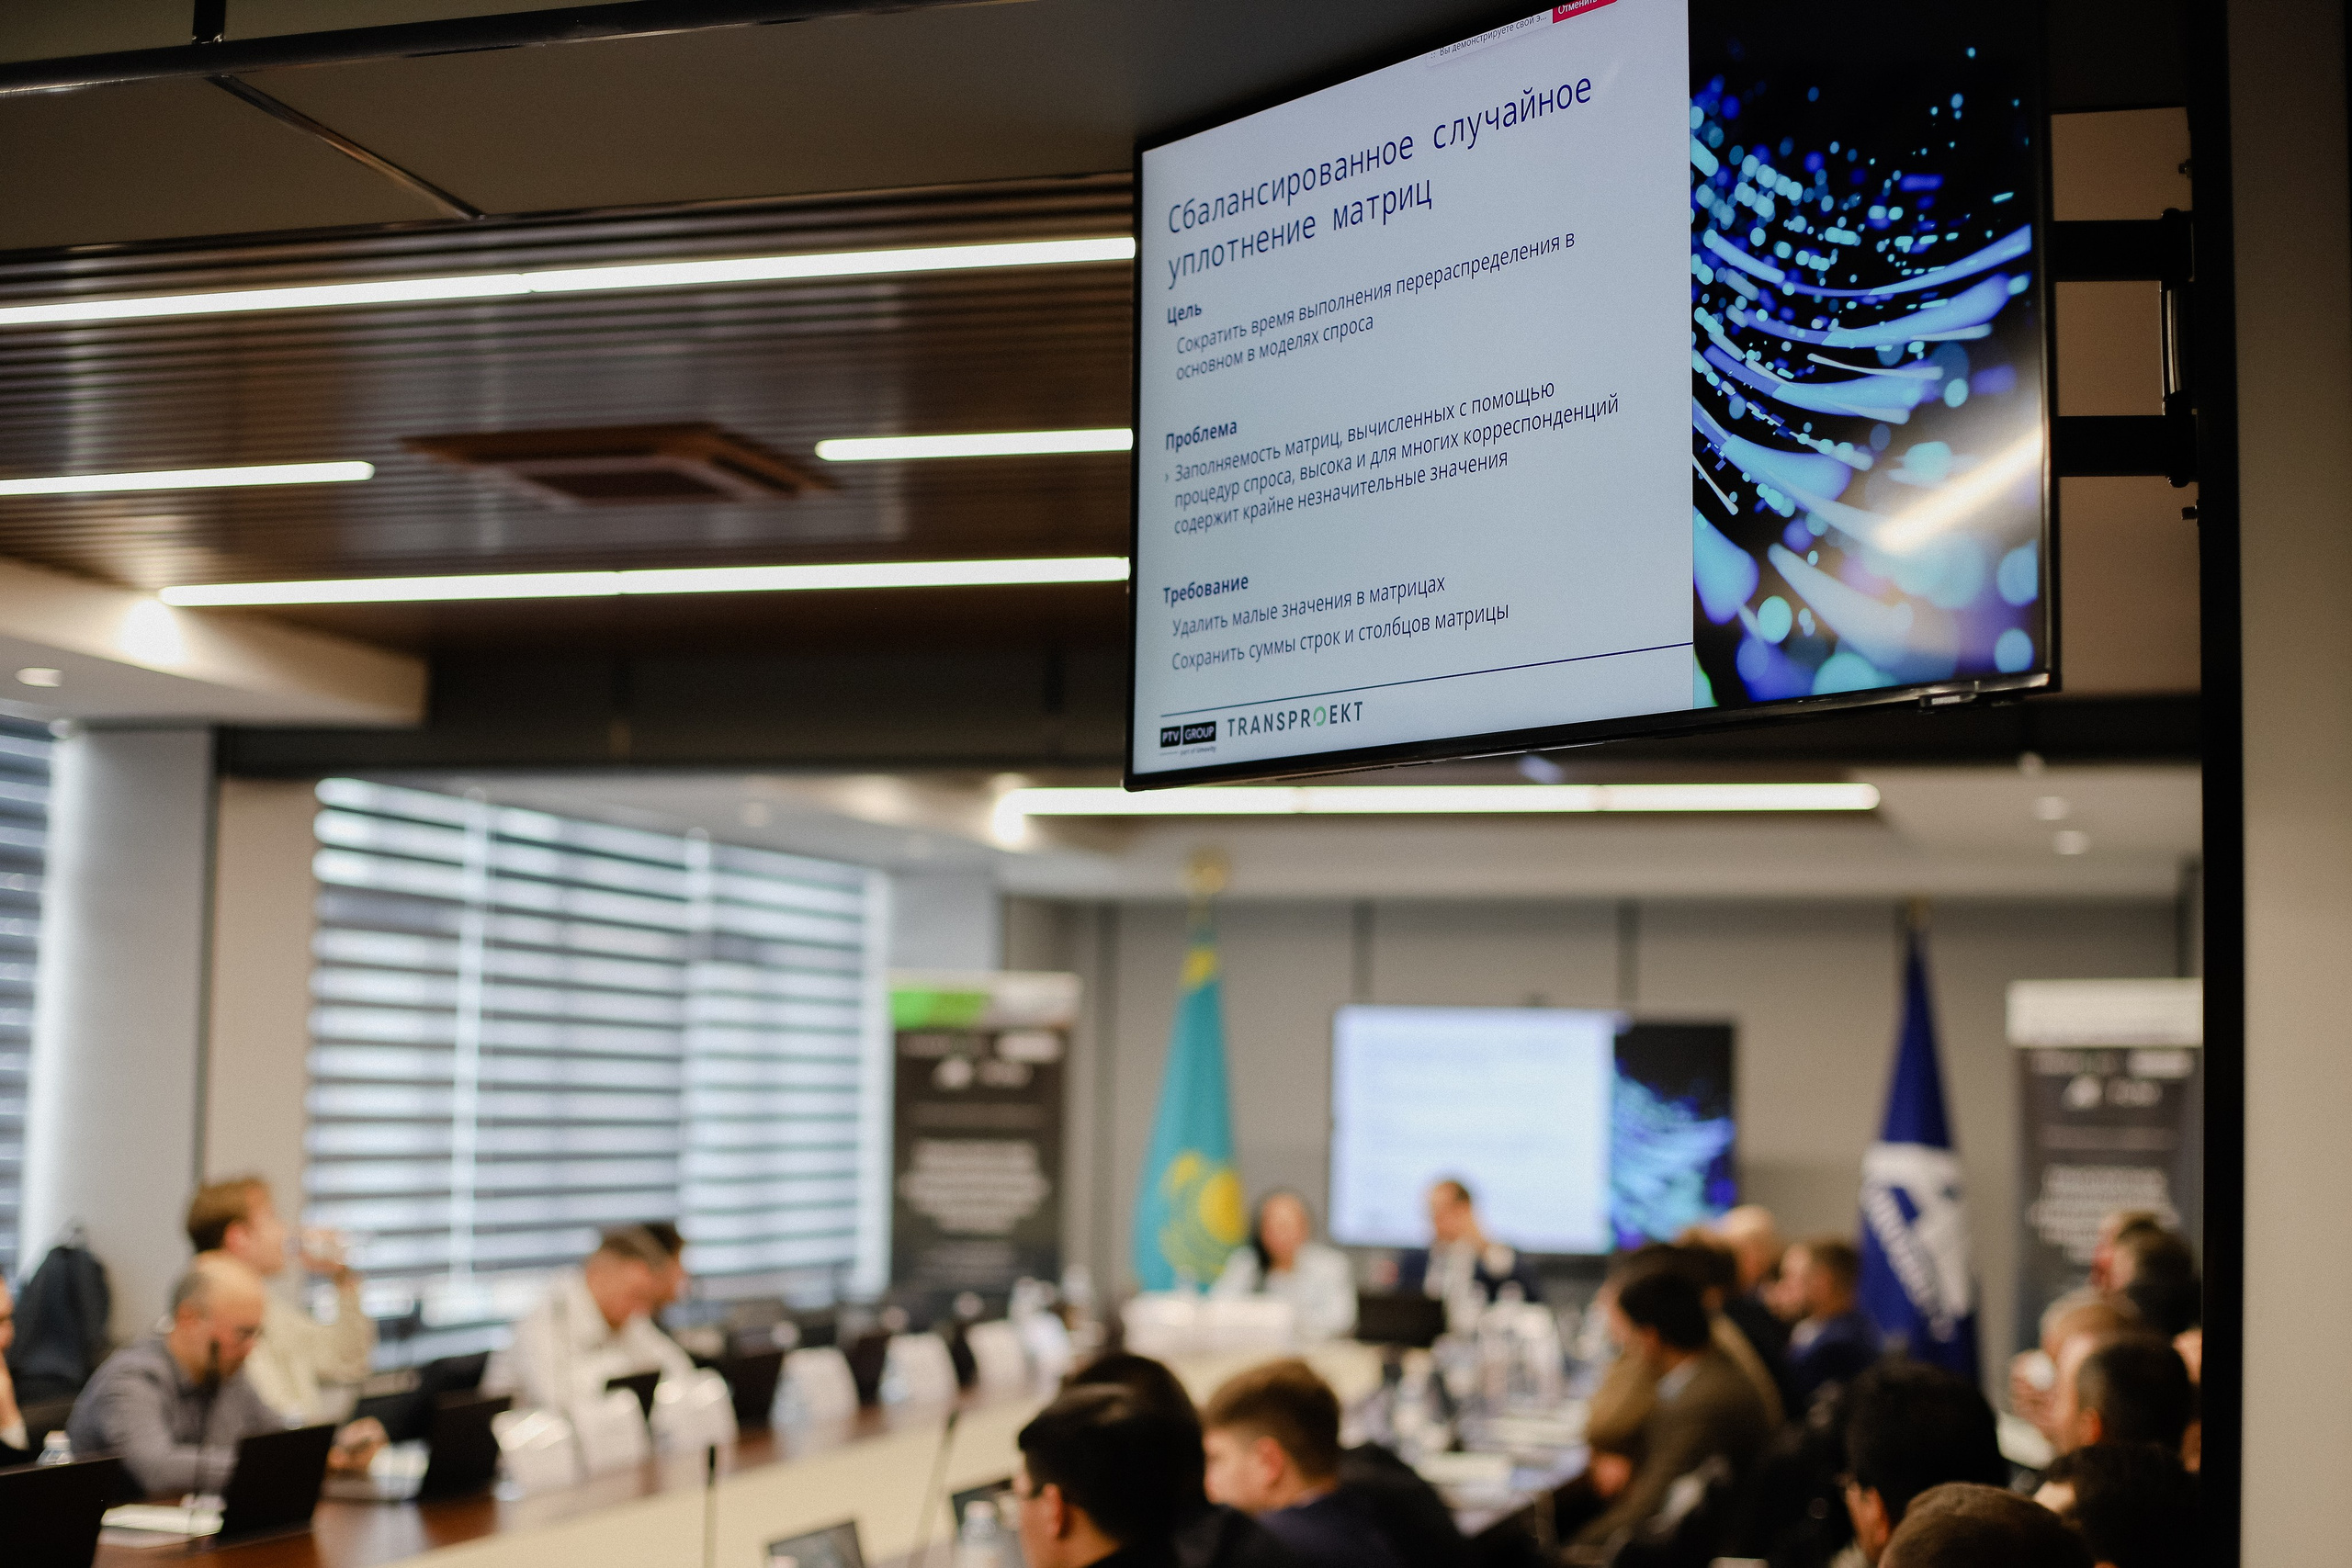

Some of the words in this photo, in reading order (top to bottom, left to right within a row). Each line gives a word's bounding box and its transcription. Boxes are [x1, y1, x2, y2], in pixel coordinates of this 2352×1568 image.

[1440, 47, 1451, 56] Вы
[1452, 24, 1514, 52] демонстрируете
[1168, 132, 1415, 235] Сбалансированное
[1431, 73, 1593, 152] случайное
[1167, 218, 1317, 290] уплотнение
[1332, 179, 1433, 233] матриц
[1167, 301, 1203, 325] Цель
[1176, 323, 1248, 355] Сократить
[1250, 309, 1295, 336] время
[1298, 285, 1393, 321] выполнения
[1395, 241, 1561, 296] перераспределения
[1565, 231, 1576, 250] в
[1175, 354, 1244, 381] основном
[1246, 349, 1256, 362] в
[1259, 329, 1320, 358] моделях
[1322, 317, 1374, 344] спроса
[1165, 420, 1238, 453] Проблема
[1174, 445, 1282, 482] Заполняемость
[1284, 429, 1344, 459] матриц,
[1347, 402, 1455, 444] вычисленных
[1458, 401, 1467, 417] с
[1471, 380, 1555, 416] помощью
[1175, 481, 1240, 511] процедур
[1243, 469, 1296, 495] спроса,
[1299, 450, 1353, 482] высока
[1355, 453, 1367, 469] и
[1369, 446, 1398, 470] для
[1401, 432, 1461, 458] многих
[1463, 392, 1620, 448] корреспонденций
[1174, 508, 1240, 534] содержит
[1243, 496, 1295, 524] крайне
[1297, 469, 1427, 510] незначительные
[1429, 449, 1510, 482] значения
[1162, 574, 1250, 608] Требование
[1172, 614, 1228, 639] Удалить
[1232, 605, 1279, 626] малые
[1281, 589, 1352, 618] значения
[1357, 590, 1366, 606] в
[1369, 577, 1447, 606] матрицах
[1171, 647, 1246, 672] Сохранить
[1249, 637, 1296, 663] суммы
[1299, 626, 1341, 652] строк
[1344, 627, 1354, 643] и
[1357, 611, 1431, 642] столбцов
[1433, 602, 1510, 634] матрицы
[1162, 730, 1180, 743] PTV
[1184, 725, 1215, 740] GROUP
[1227, 701, 1364, 738] TRANSPROEKT
